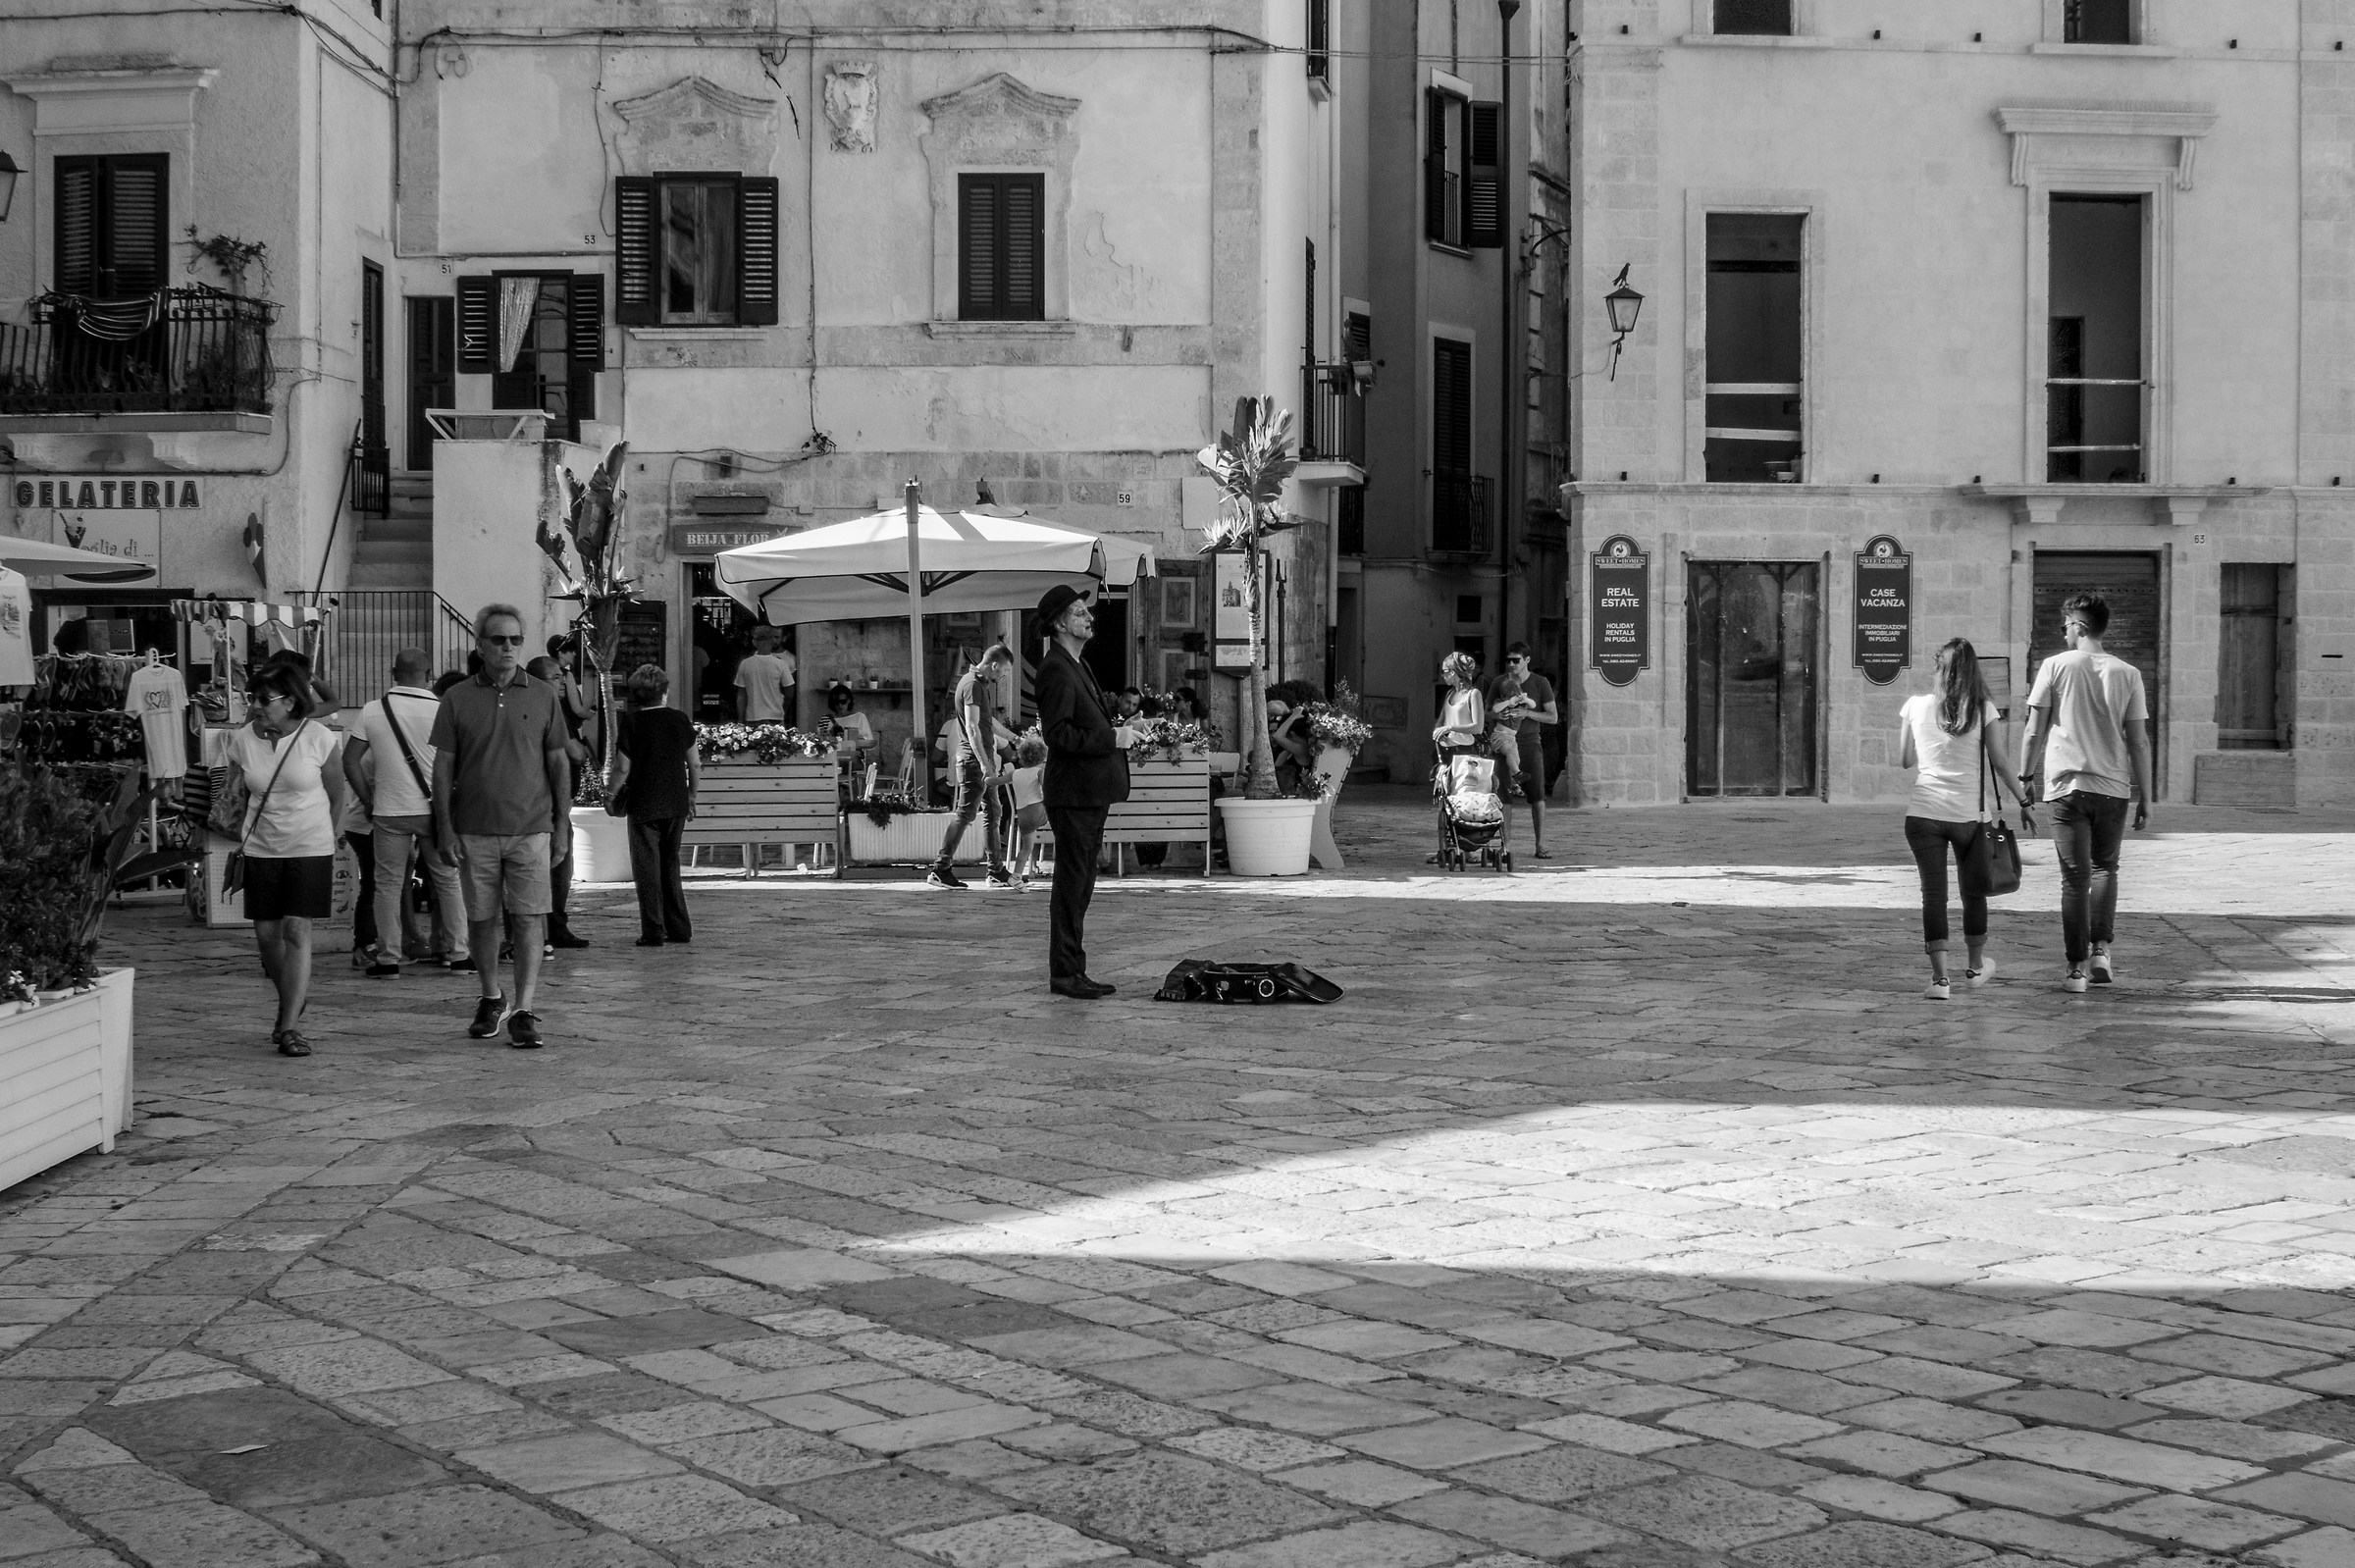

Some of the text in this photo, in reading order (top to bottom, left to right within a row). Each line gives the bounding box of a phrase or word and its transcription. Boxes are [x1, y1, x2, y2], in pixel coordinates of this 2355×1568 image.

[584, 235, 596, 244] 53
[442, 264, 451, 274] 51
[16, 480, 200, 508] GELATERIA
[1119, 494, 1130, 503] 59
[687, 534, 726, 545] BEIJA
[2194, 535, 2205, 545] 63
[124, 539, 138, 557] di
[1606, 588, 1635, 597] REAL
[1870, 589, 1896, 598] CASE
[1601, 599, 1640, 607] ESTATE
[1860, 599, 1906, 607] VACANZA
